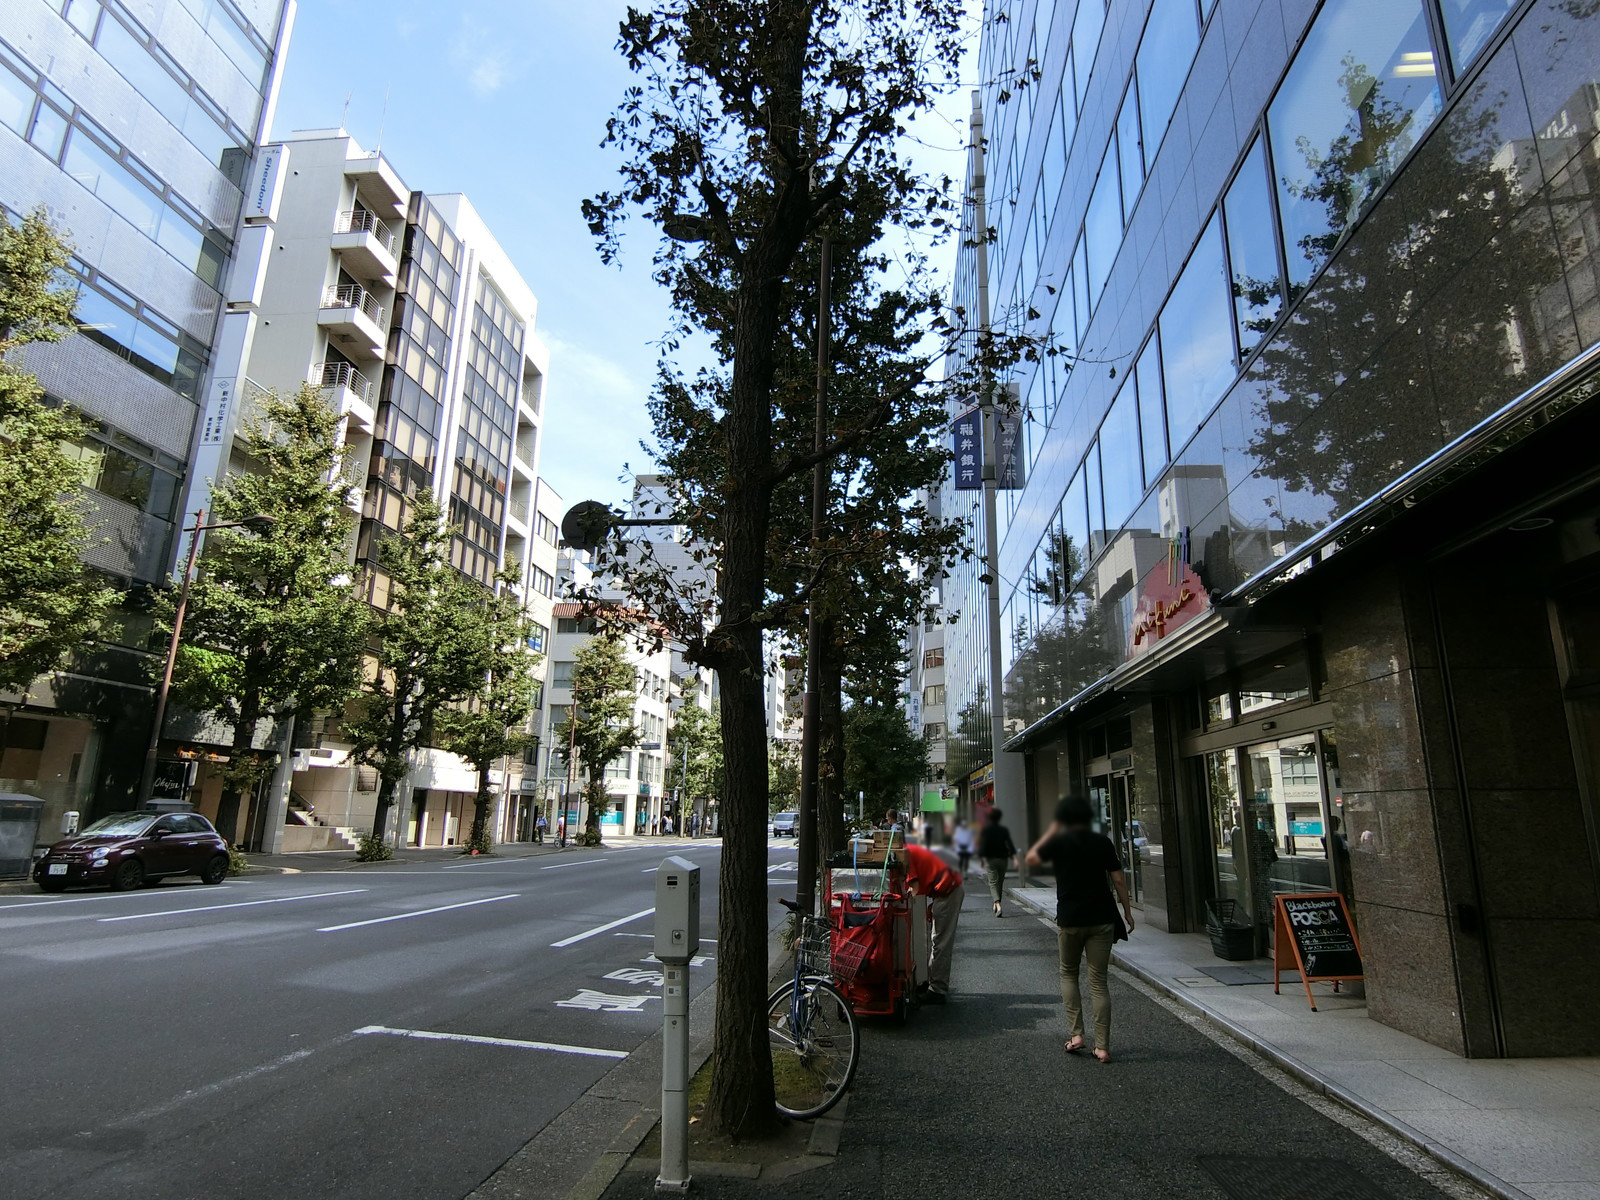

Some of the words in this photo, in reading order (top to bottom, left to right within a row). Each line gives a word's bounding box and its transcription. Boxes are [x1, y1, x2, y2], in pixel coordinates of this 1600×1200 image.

[257, 156, 272, 209] Sheedom
[959, 423, 975, 482] 福井銀行
[1286, 900, 1336, 912] Blackboard
[1290, 909, 1338, 926] POSCA
